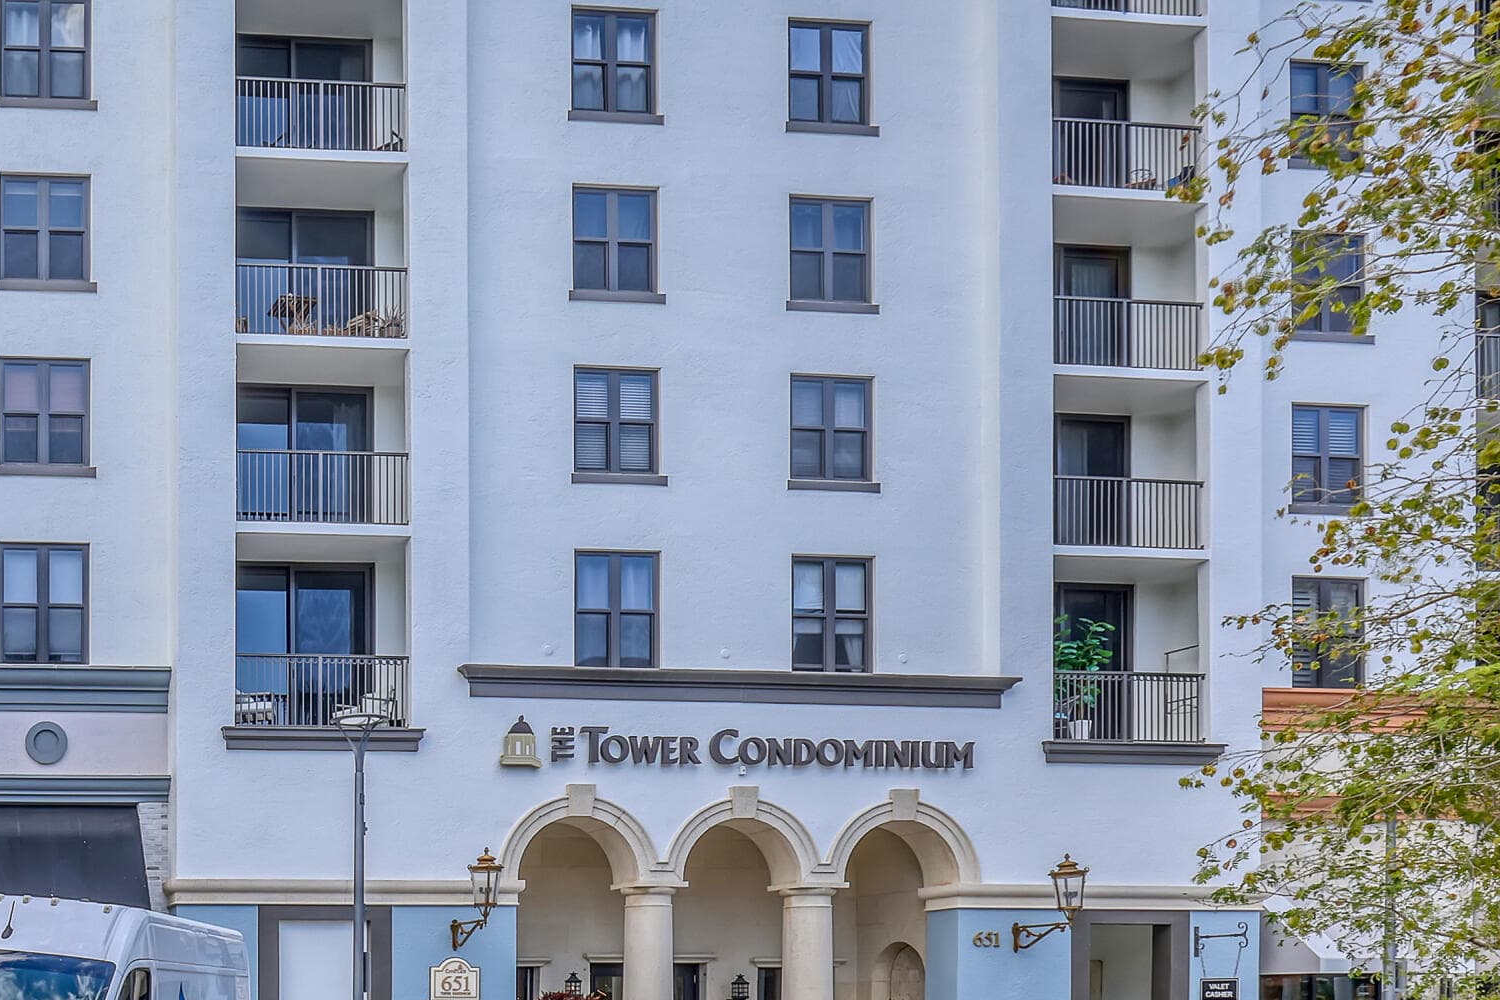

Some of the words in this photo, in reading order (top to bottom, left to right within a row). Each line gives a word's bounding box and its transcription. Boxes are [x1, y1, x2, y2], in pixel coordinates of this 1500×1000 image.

[551, 727, 575, 762] THE
[973, 931, 1000, 948] 651
[441, 975, 470, 992] 651
